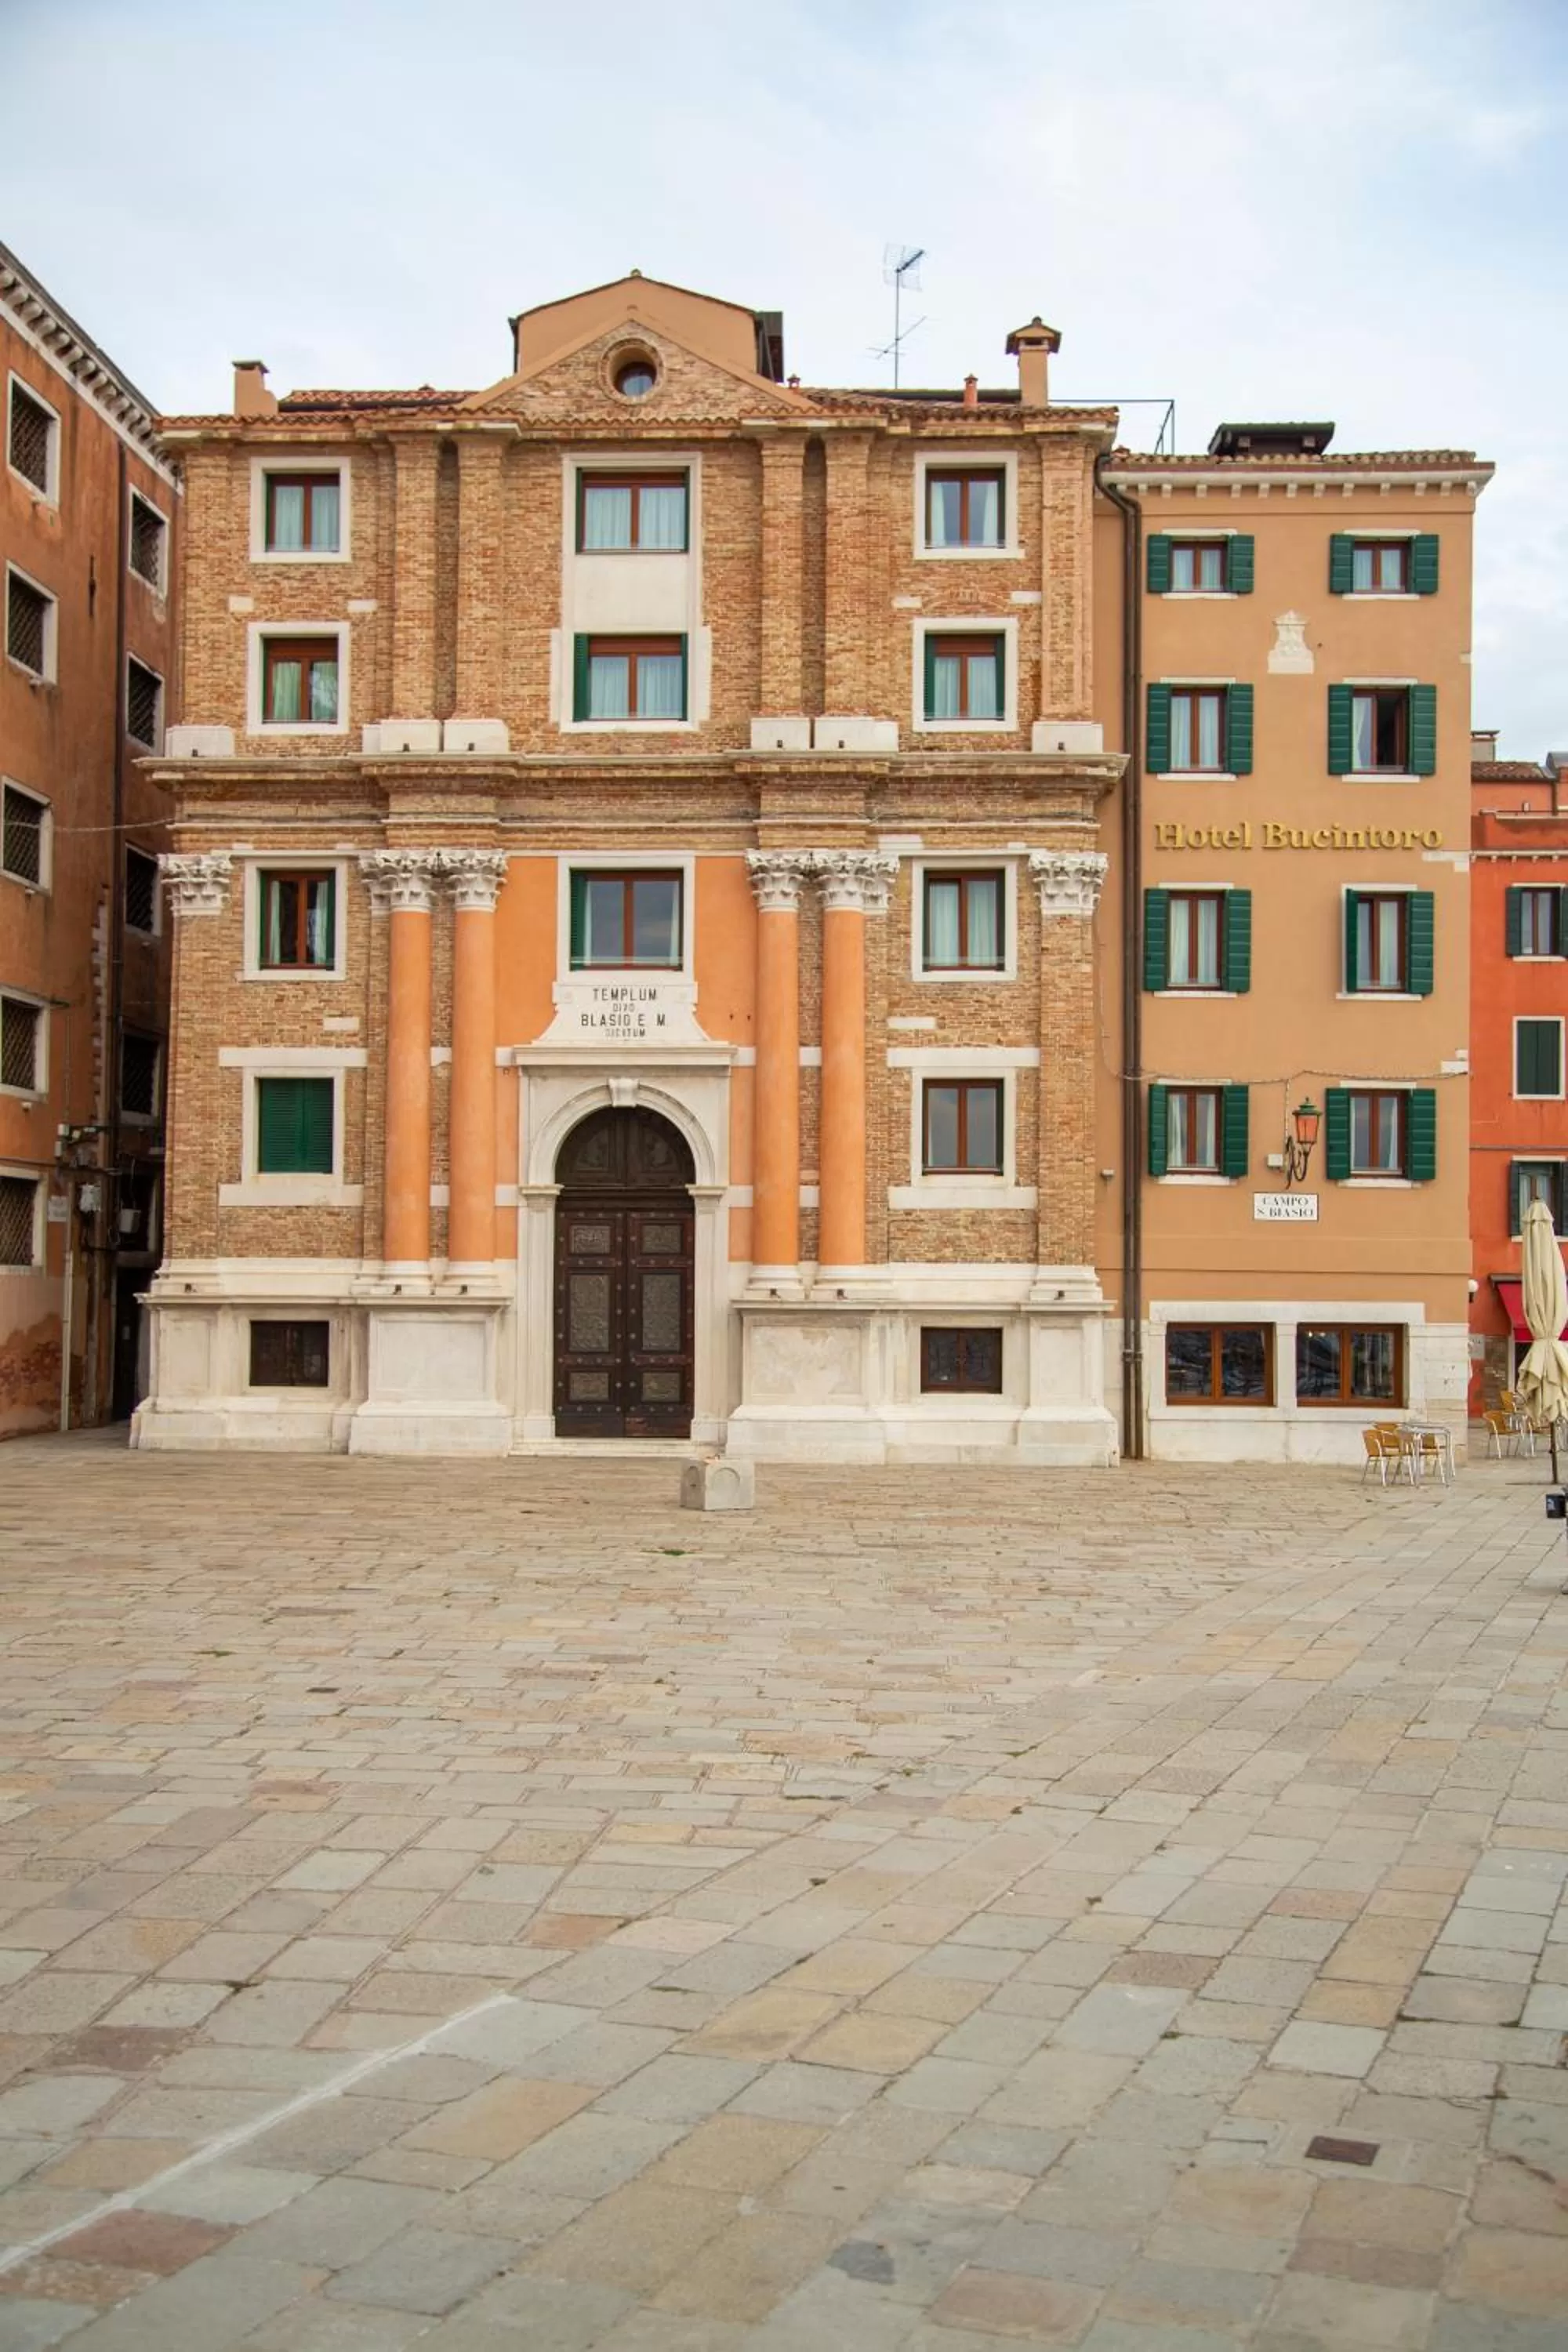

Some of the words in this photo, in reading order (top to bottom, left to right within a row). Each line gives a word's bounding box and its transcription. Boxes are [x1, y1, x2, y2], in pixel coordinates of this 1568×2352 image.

[1155, 821, 1252, 850] Hotel
[1261, 821, 1444, 850] Bucintoro
[593, 988, 657, 1001] TEMPLUM
[581, 1014, 631, 1026] BLASIO
[1261, 1196, 1308, 1206] CAMPO
